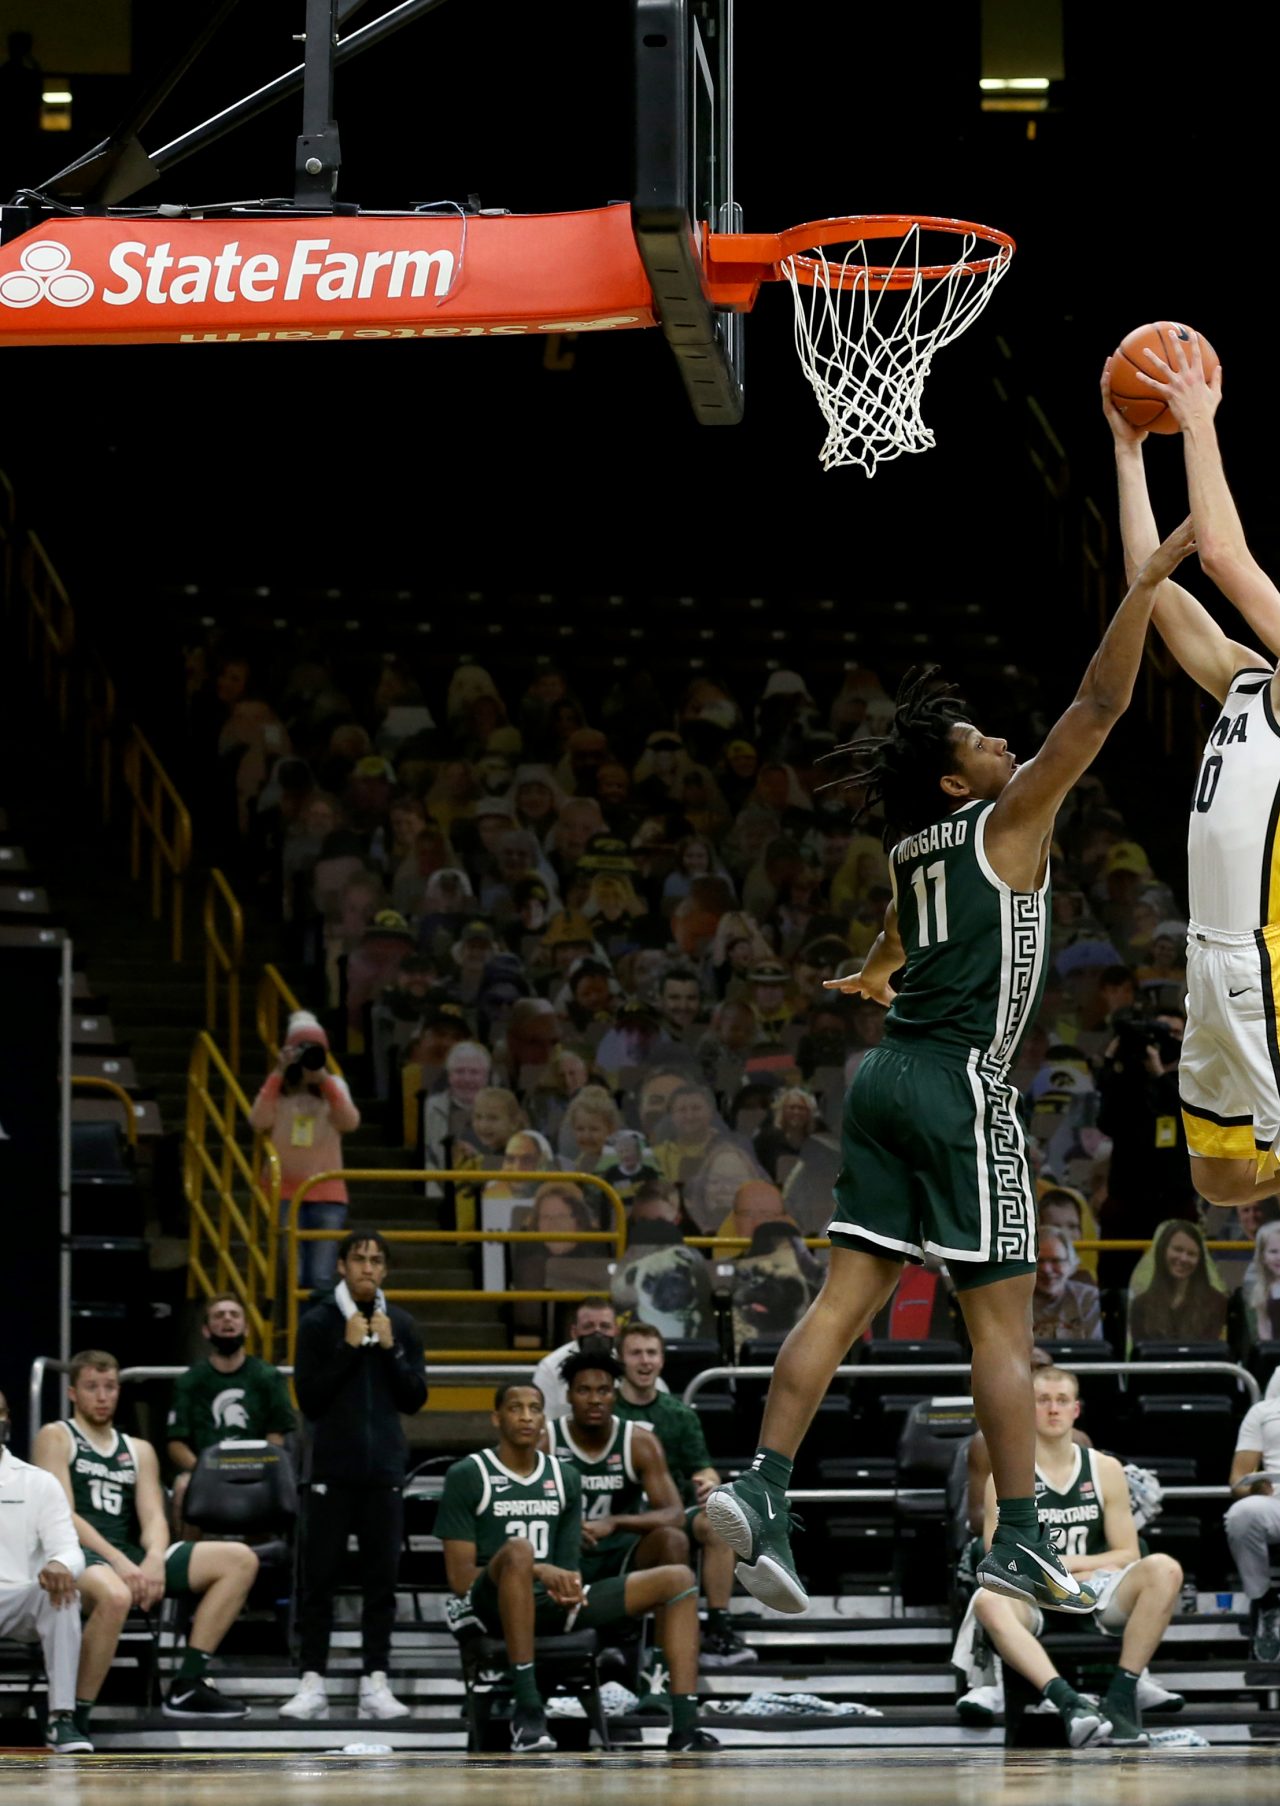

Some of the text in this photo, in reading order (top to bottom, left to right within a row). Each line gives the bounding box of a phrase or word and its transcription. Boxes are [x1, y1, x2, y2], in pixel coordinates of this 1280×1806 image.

[910, 860, 948, 948] 11
[581, 1475, 625, 1490] RTANS
[88, 1479, 122, 1516] 15
[493, 1501, 559, 1516] SPARTANS
